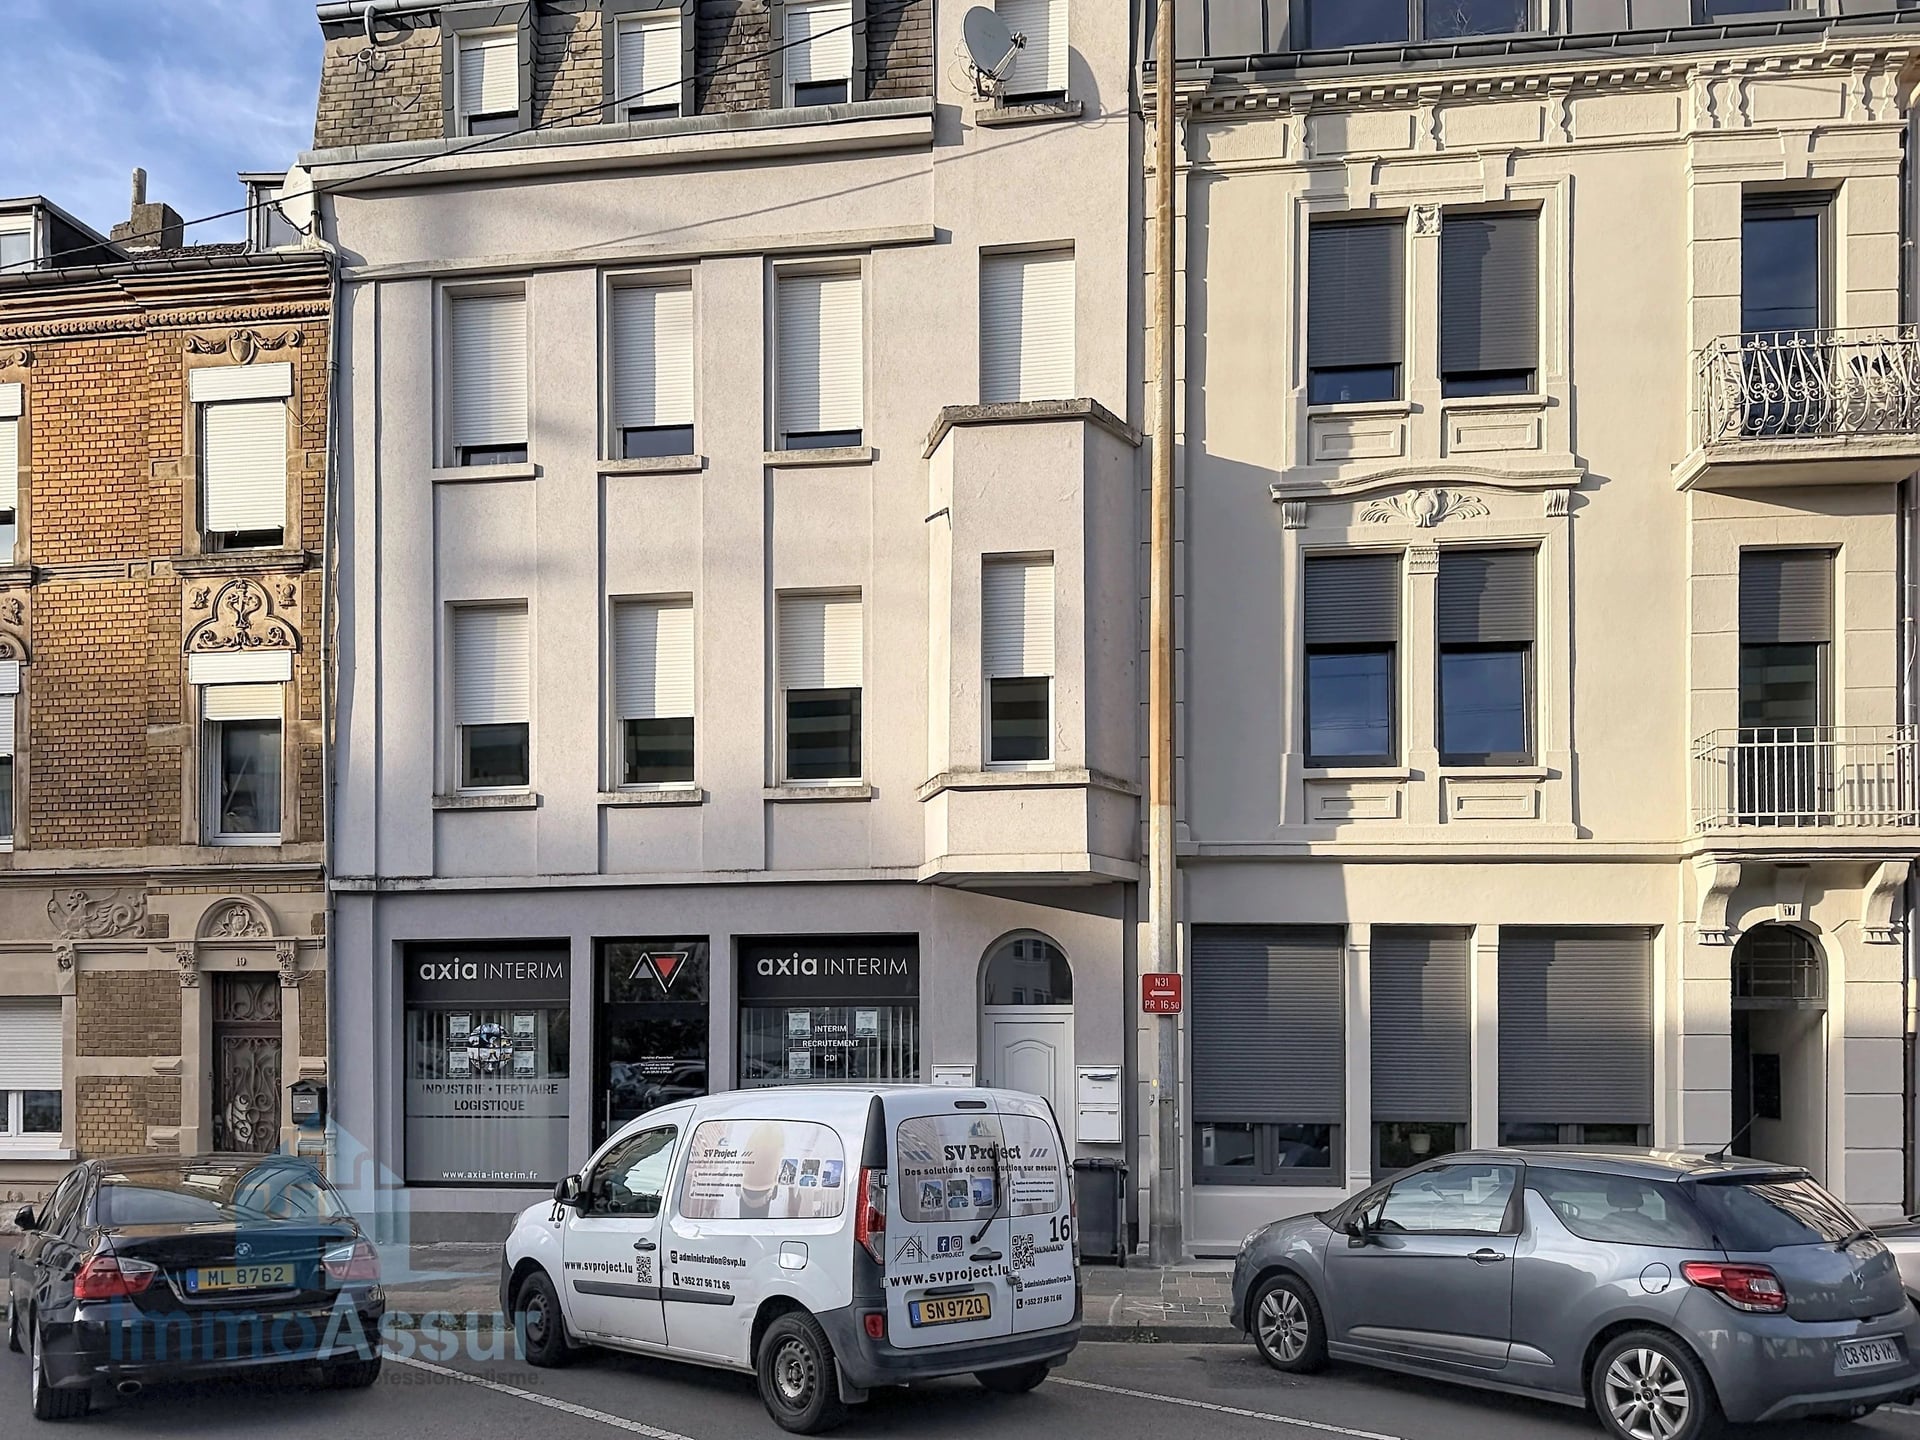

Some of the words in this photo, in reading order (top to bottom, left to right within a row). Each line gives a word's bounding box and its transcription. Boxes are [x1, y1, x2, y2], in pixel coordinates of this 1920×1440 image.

[419, 957, 478, 980] axia
[483, 962, 564, 980] INTERIM
[756, 952, 818, 976] axia
[823, 957, 909, 976] INTERIM
[1154, 977, 1169, 987] N31
[1144, 1000, 1156, 1009] PR
[814, 1025, 848, 1034] INTERIM
[802, 1039, 860, 1048] RECRUTEMENT
[823, 1054, 838, 1062] CDI
[495, 1083, 559, 1095] TERTIAIRE
[454, 1100, 526, 1112] LOGISTIQUE
[703, 1149, 714, 1158] SV
[714, 1148, 738, 1160] Project
[944, 1144, 967, 1161] SV
[442, 1169, 538, 1180] www.axia-interim.fr
[924, 1165, 963, 1175] solutions
[548, 1201, 566, 1222] 16
[1049, 1215, 1070, 1242] 16
[564, 1260, 633, 1275] www.svproject.lu
[678, 1253, 746, 1268] administration@svp.lu
[207, 1269, 231, 1286] ML
[236, 1266, 284, 1285] 8762
[889, 1264, 1009, 1287] www.svproject.lu
[681, 1276, 696, 1286] +352
[696, 1277, 703, 1287] 27
[704, 1279, 713, 1288] 56
[714, 1279, 721, 1289] 71
[721, 1280, 731, 1290] 66
[926, 1302, 945, 1319] SN
[947, 1298, 982, 1318] 9720
